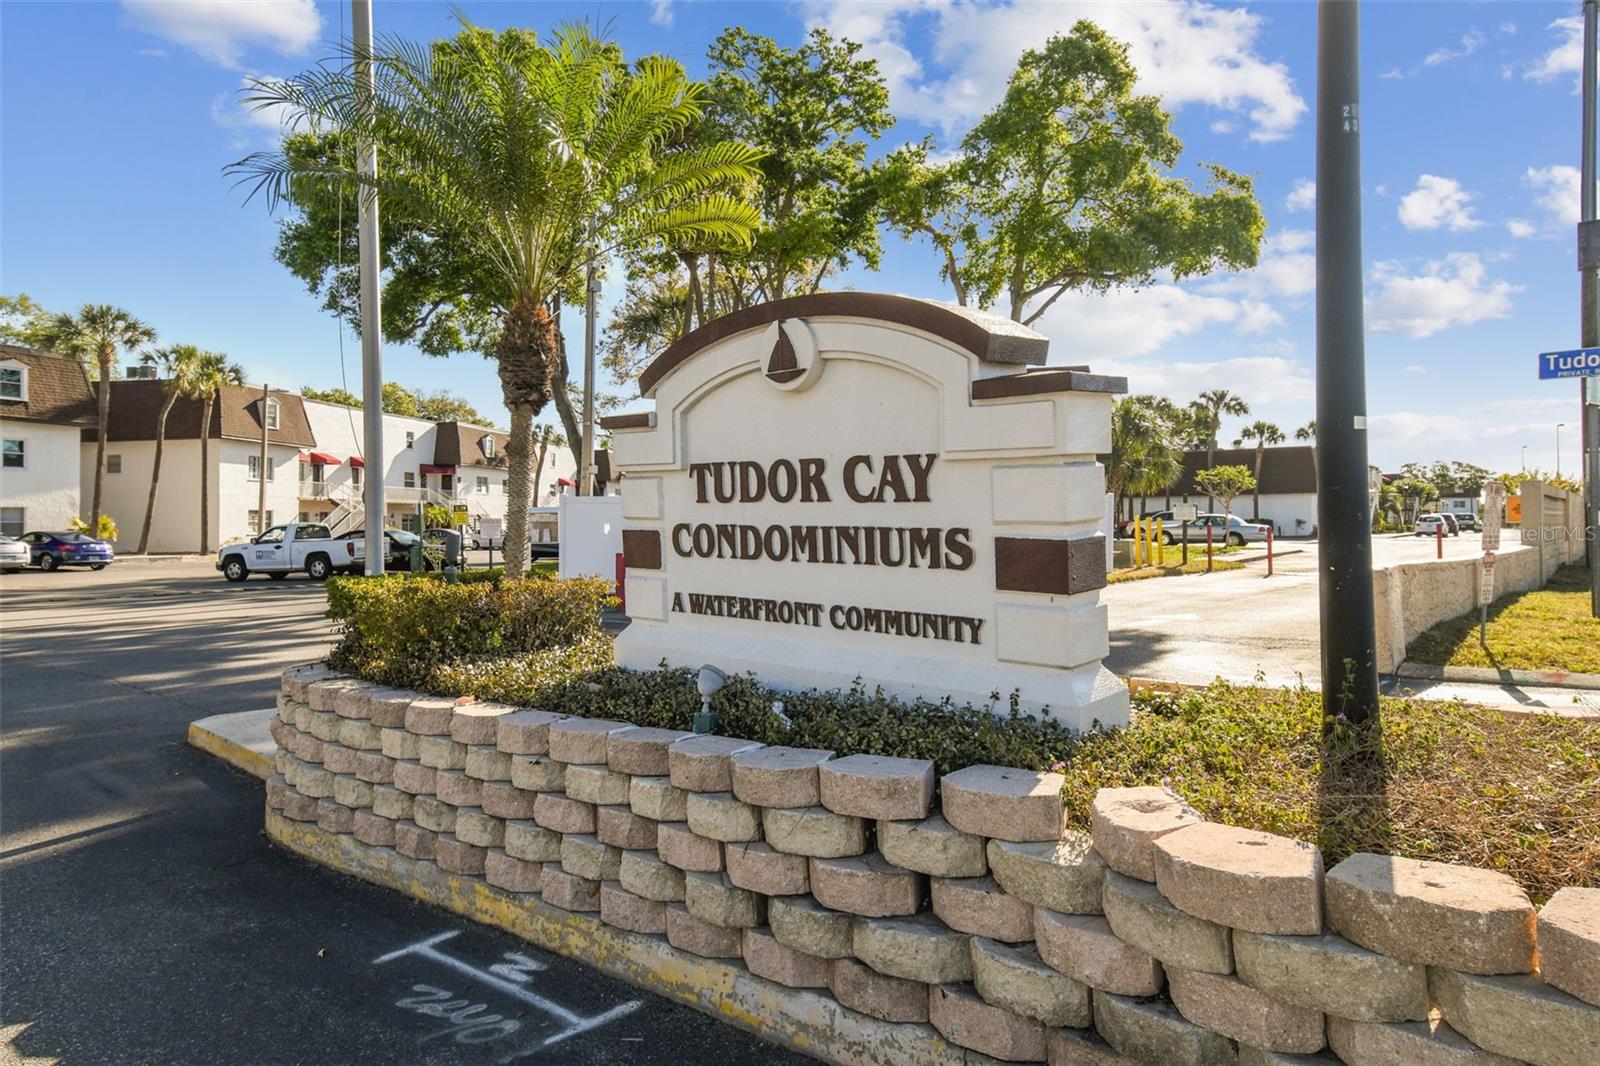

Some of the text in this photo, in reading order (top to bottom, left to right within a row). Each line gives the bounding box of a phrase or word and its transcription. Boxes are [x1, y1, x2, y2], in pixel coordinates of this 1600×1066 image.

[1558, 369, 1589, 377] PRIVATE
[689, 453, 939, 504] TUDOR CAY
[672, 523, 975, 571] CONDOMINIUMS
[671, 592, 986, 645] A WATERFRONT COMMUNITY
